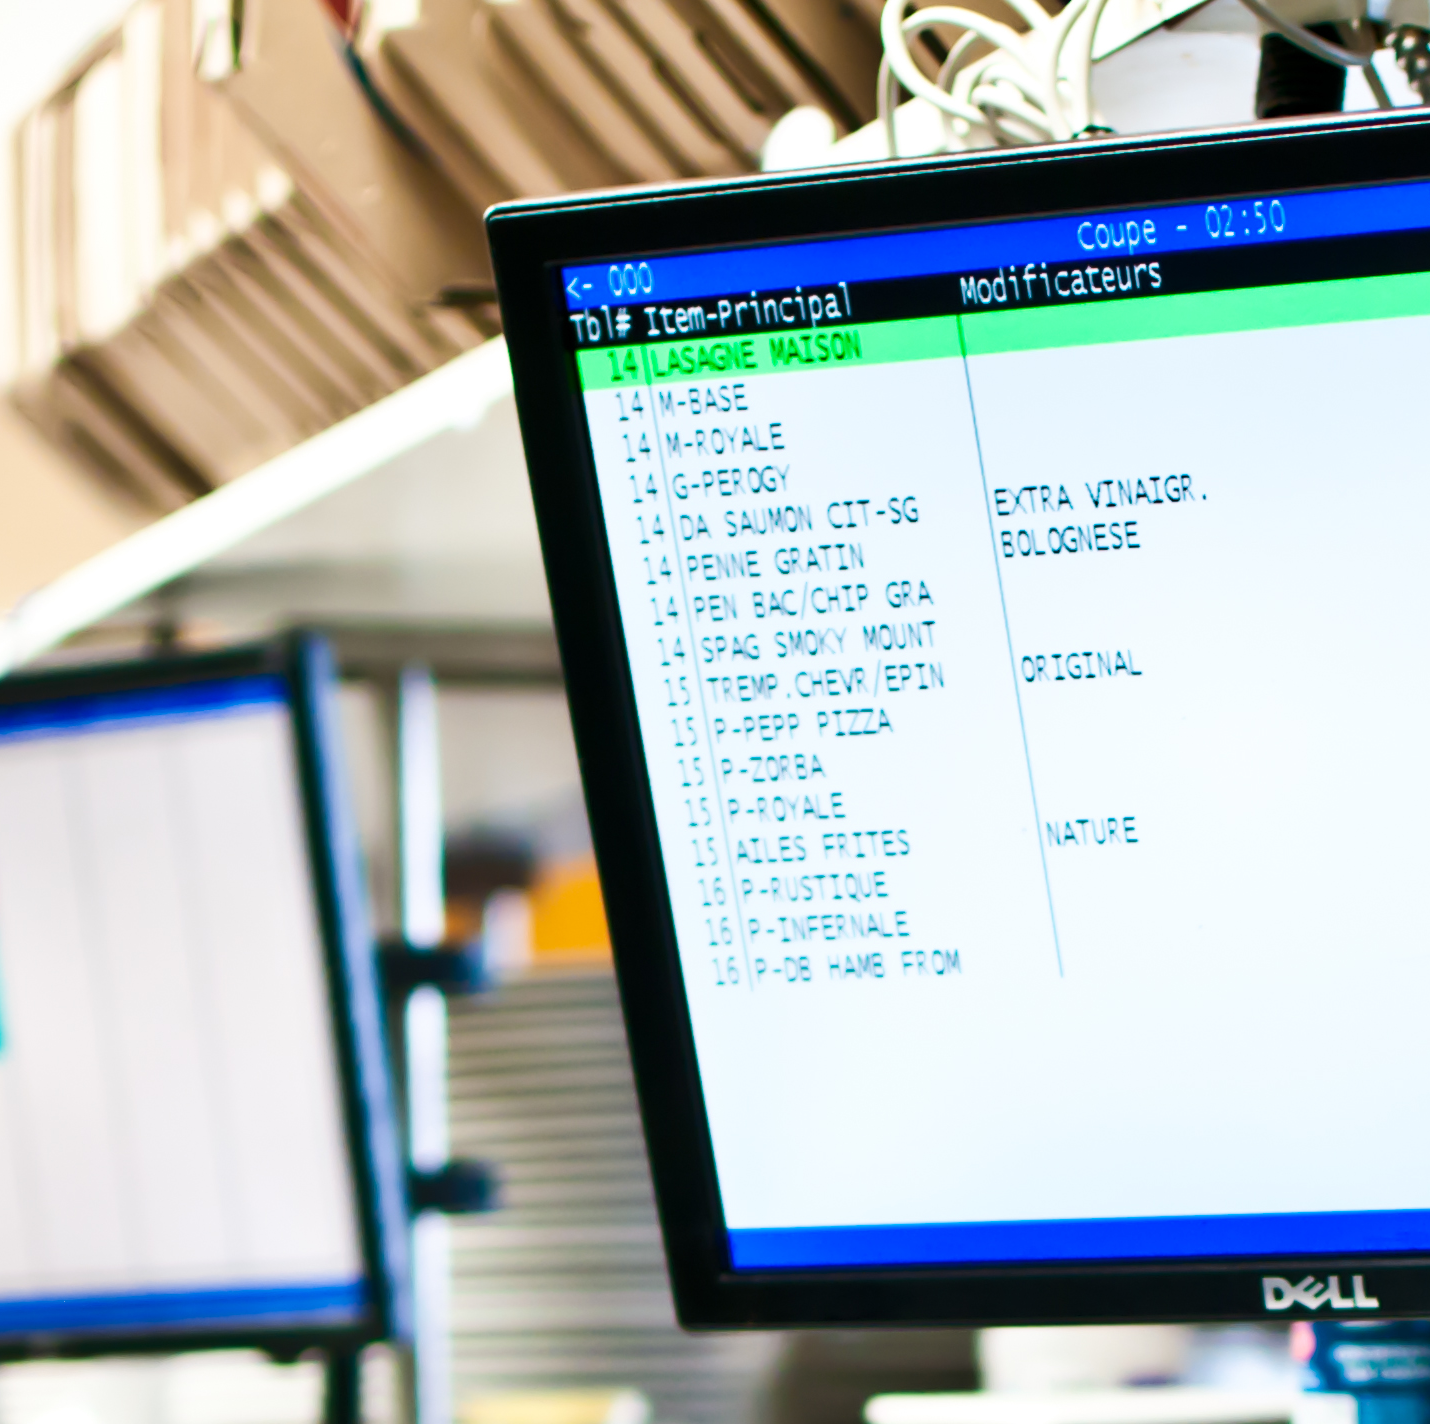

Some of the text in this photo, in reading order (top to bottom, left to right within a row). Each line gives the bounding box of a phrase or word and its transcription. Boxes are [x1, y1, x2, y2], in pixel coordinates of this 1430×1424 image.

[1077, 218, 1158, 256] Coupe
[1205, 198, 1286, 240] 02:50
[959, 261, 1164, 306] Modificateurs
[570, 280, 852, 343] Tbl# Item-Principal
[607, 329, 864, 382] 14 LASAGNE MAISON
[615, 382, 750, 423] 14 M-BASE
[622, 422, 785, 464] 14 M-ROYALE
[630, 463, 791, 504] 14 G-PEROGY
[994, 473, 1208, 516] EXTRA VINAIGR.
[637, 496, 920, 545] 14 DA SAUMON CIT-SG
[1000, 520, 1141, 558] BOLOGNESE
[644, 542, 865, 586] 14 PENNE GRATIN
[651, 580, 936, 626] 14 PEN BAC/CHIP GRA
[658, 620, 936, 667] 14 SPAG SMOKY MOUNT
[1021, 648, 1144, 684] ORIGINAL
[665, 676, 692, 708] 15
[671, 707, 895, 748] 15 P-PEPP PIZZA
[678, 753, 828, 788] 15 P-ZORBA
[685, 791, 847, 828] 15 P-ROYALE
[692, 829, 911, 868] 15 AILES FRITES
[1046, 815, 1140, 847] NATURE
[698, 870, 890, 907] 16 P-RUSTIQUE
[705, 910, 911, 947] 16 P-INFERNALE
[712, 955, 741, 987] 16
[826, 950, 886, 981] HAMB
[900, 948, 963, 978] FROM
[1262, 1275, 1380, 1310] DELL
